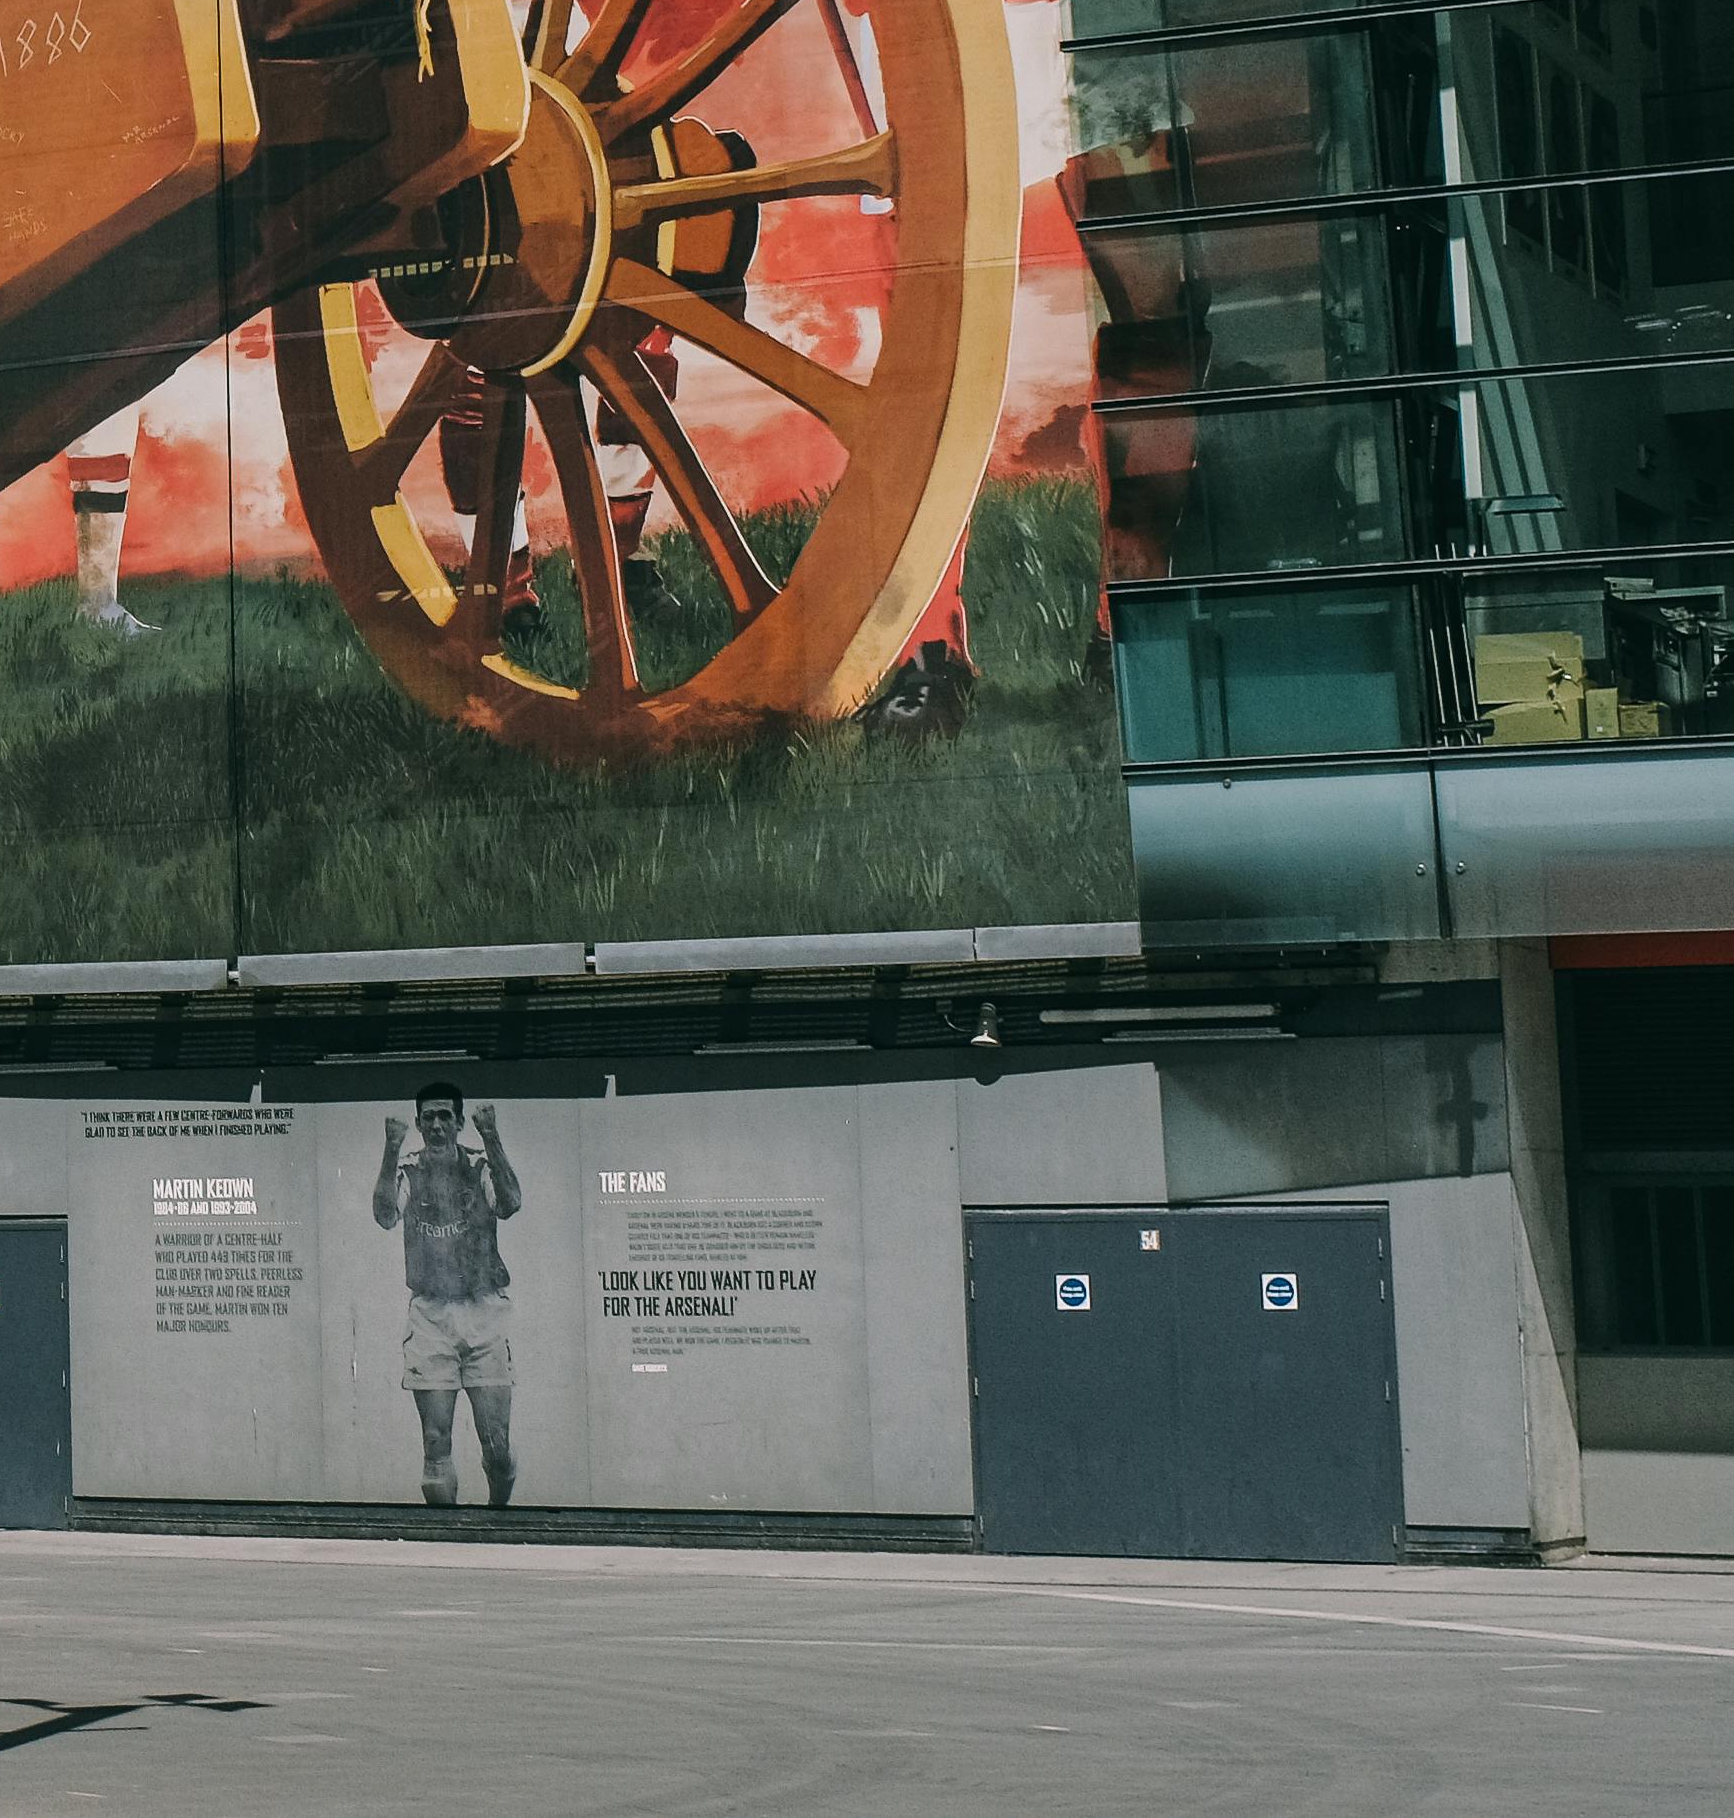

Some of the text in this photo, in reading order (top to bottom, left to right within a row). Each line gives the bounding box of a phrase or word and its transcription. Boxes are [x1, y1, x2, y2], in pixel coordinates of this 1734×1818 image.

[153, 1178, 254, 1199] MARTIN KEOWN
[599, 1171, 666, 1193] THE FANS
[191, 1202, 208, 1215] AND
[155, 1233, 283, 1246] A WARRIOR OF A CENTRE-HALF
[155, 1251, 174, 1263] WHO
[176, 1251, 208, 1263] PLAYED
[232, 1251, 256, 1263] TIMES
[258, 1251, 274, 1263] FOR
[278, 1251, 293, 1263] THE
[155, 1268, 178, 1281] CLUB
[180, 1268, 201, 1281] OVER
[204, 1268, 222, 1281] TWO
[261, 1268, 303, 1281] PEERLESS
[643, 1271, 673, 1291] LIKE
[678, 1271, 706, 1291] YOU
[711, 1271, 751, 1291] WANT
[756, 1271, 774, 1291] TO
[780, 1270, 816, 1290] PLAY
[156, 1303, 167, 1315] OF
[169, 1303, 184, 1315] THE
[215, 1303, 248, 1315] MARTIN
[251, 1303, 269, 1315] WON
[273, 1303, 288, 1315] TEN
[603, 1296, 630, 1317] FOR
[634, 1296, 660, 1316] THE
[156, 1320, 186, 1333] MAJOR
